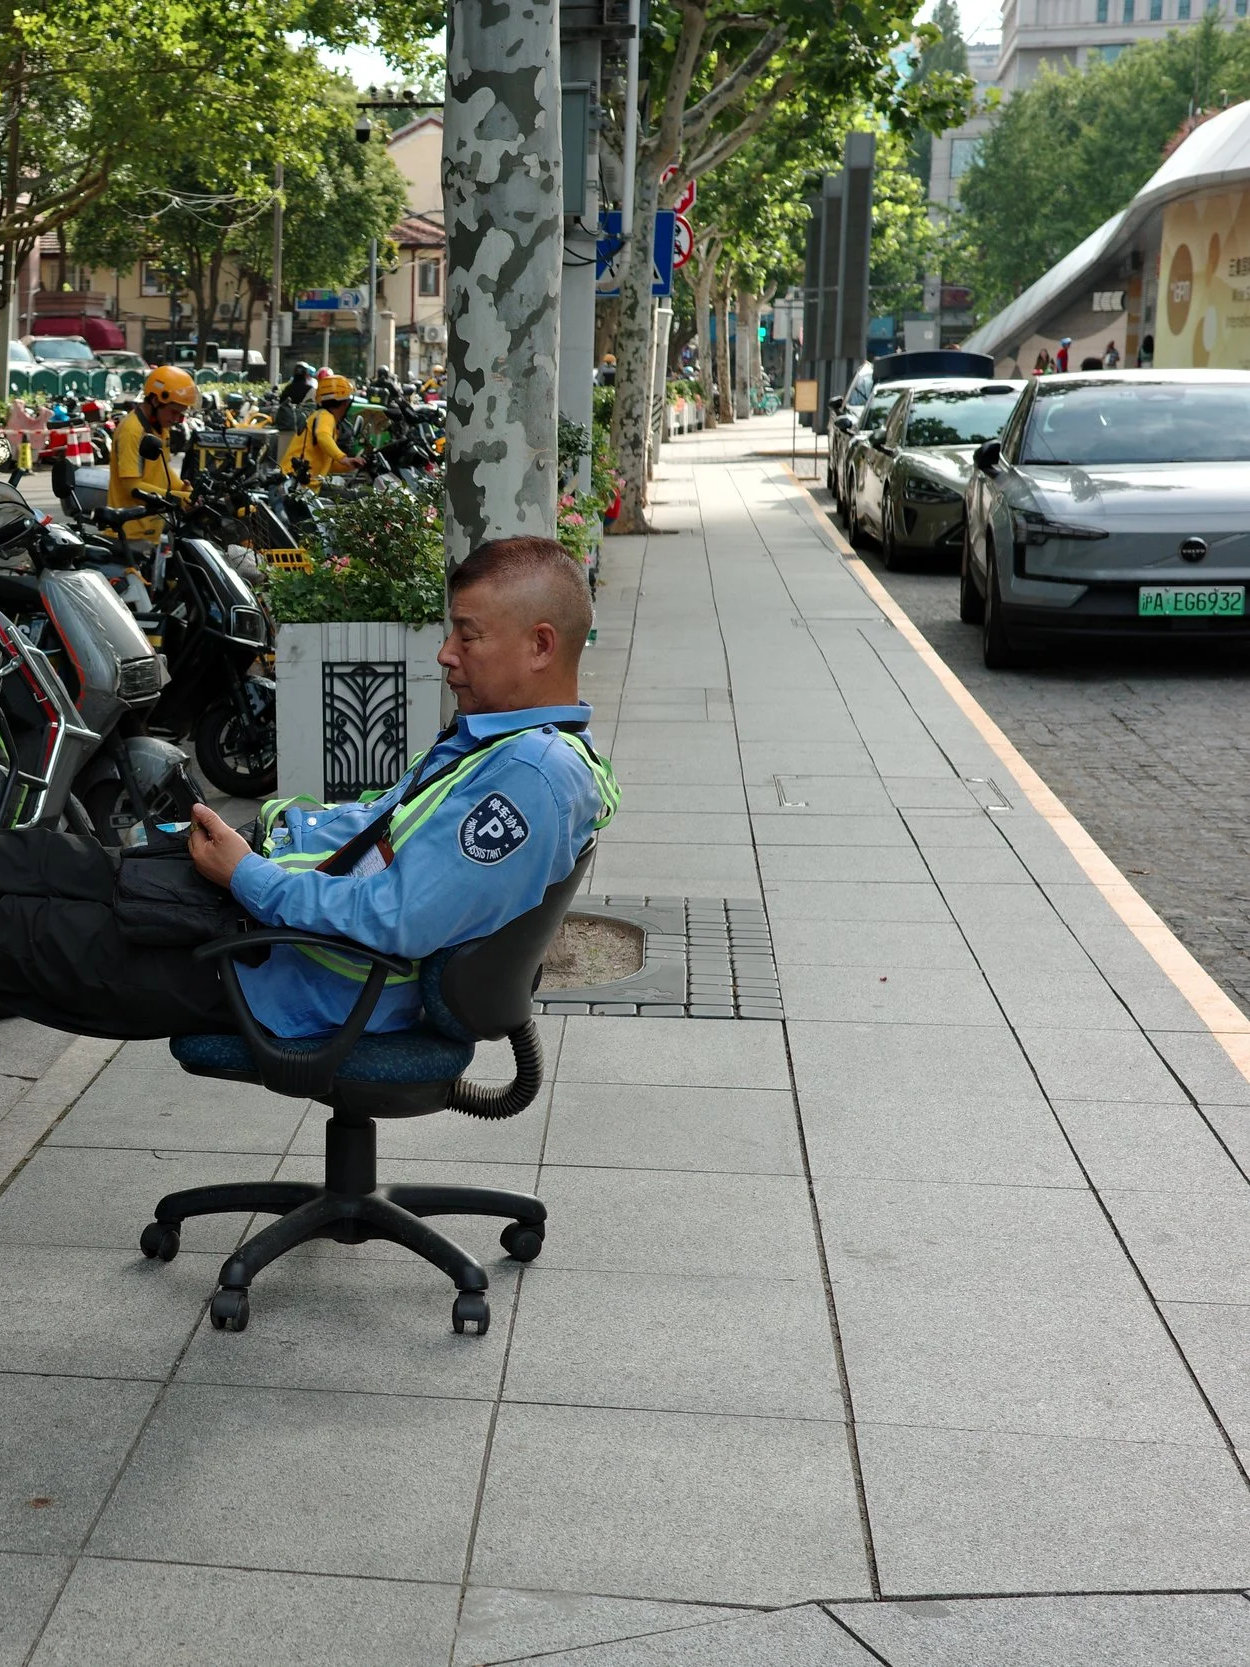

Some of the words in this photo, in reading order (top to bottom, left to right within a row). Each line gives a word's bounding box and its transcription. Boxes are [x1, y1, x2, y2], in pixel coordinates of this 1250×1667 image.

[1173, 592, 1242, 612] EG6932
[477, 816, 504, 838] P
[488, 797, 525, 839] 停车协管
[464, 816, 478, 847] PARKING
[466, 844, 503, 860] ASSISTANT
